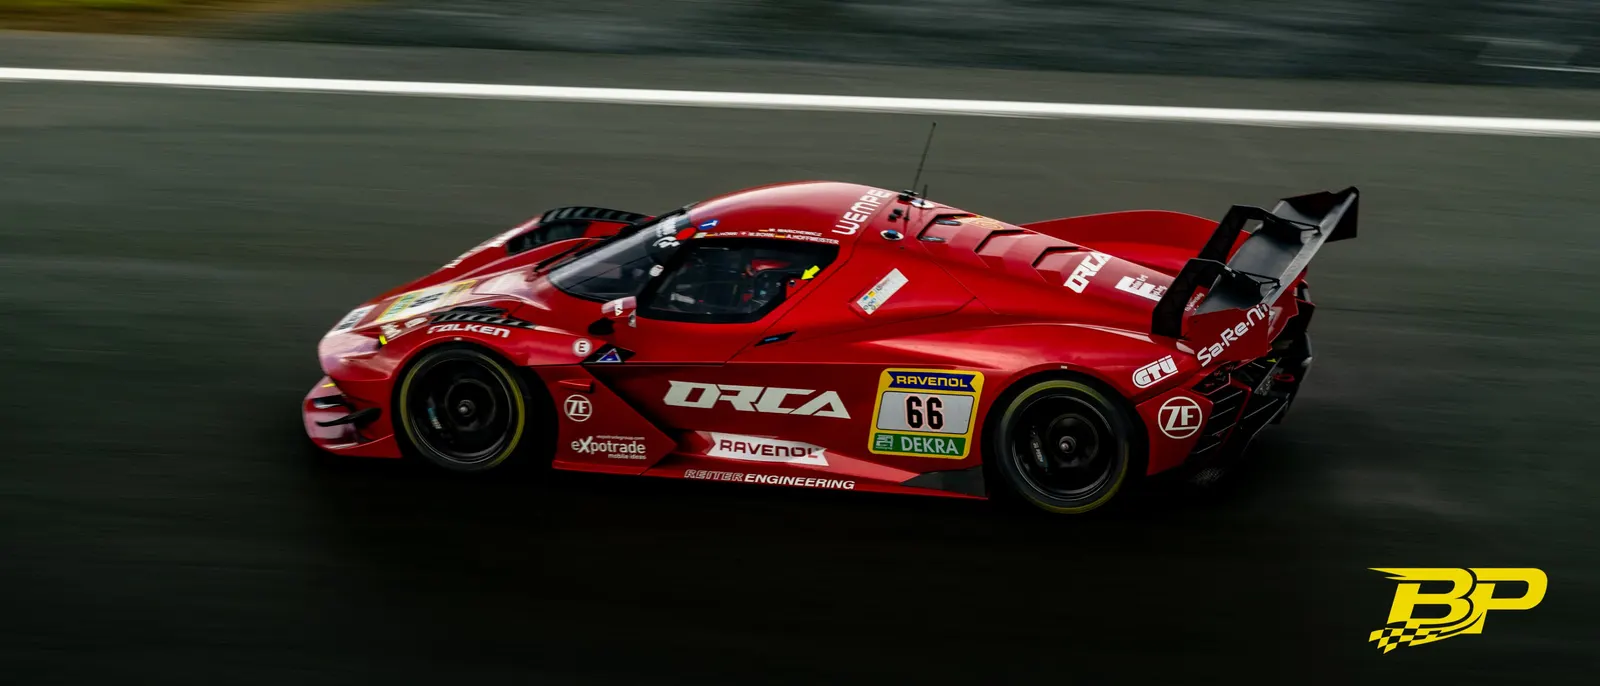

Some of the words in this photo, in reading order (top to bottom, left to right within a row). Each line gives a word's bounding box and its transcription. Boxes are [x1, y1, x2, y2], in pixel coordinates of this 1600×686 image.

[832, 189, 893, 235] WEMPE
[1063, 252, 1113, 293] ORCA
[427, 323, 511, 338] FALKEN
[896, 375, 968, 388] RAVENOL
[1132, 355, 1179, 388] GTU
[565, 398, 591, 418] ZF
[663, 380, 851, 419] ORCA
[905, 395, 944, 430] 66
[1161, 404, 1199, 432] ZF
[720, 439, 818, 458] RAVENOL
[901, 436, 959, 455] DEKRA
[684, 469, 743, 482] REITER
[744, 473, 856, 490] ENGINEERING
